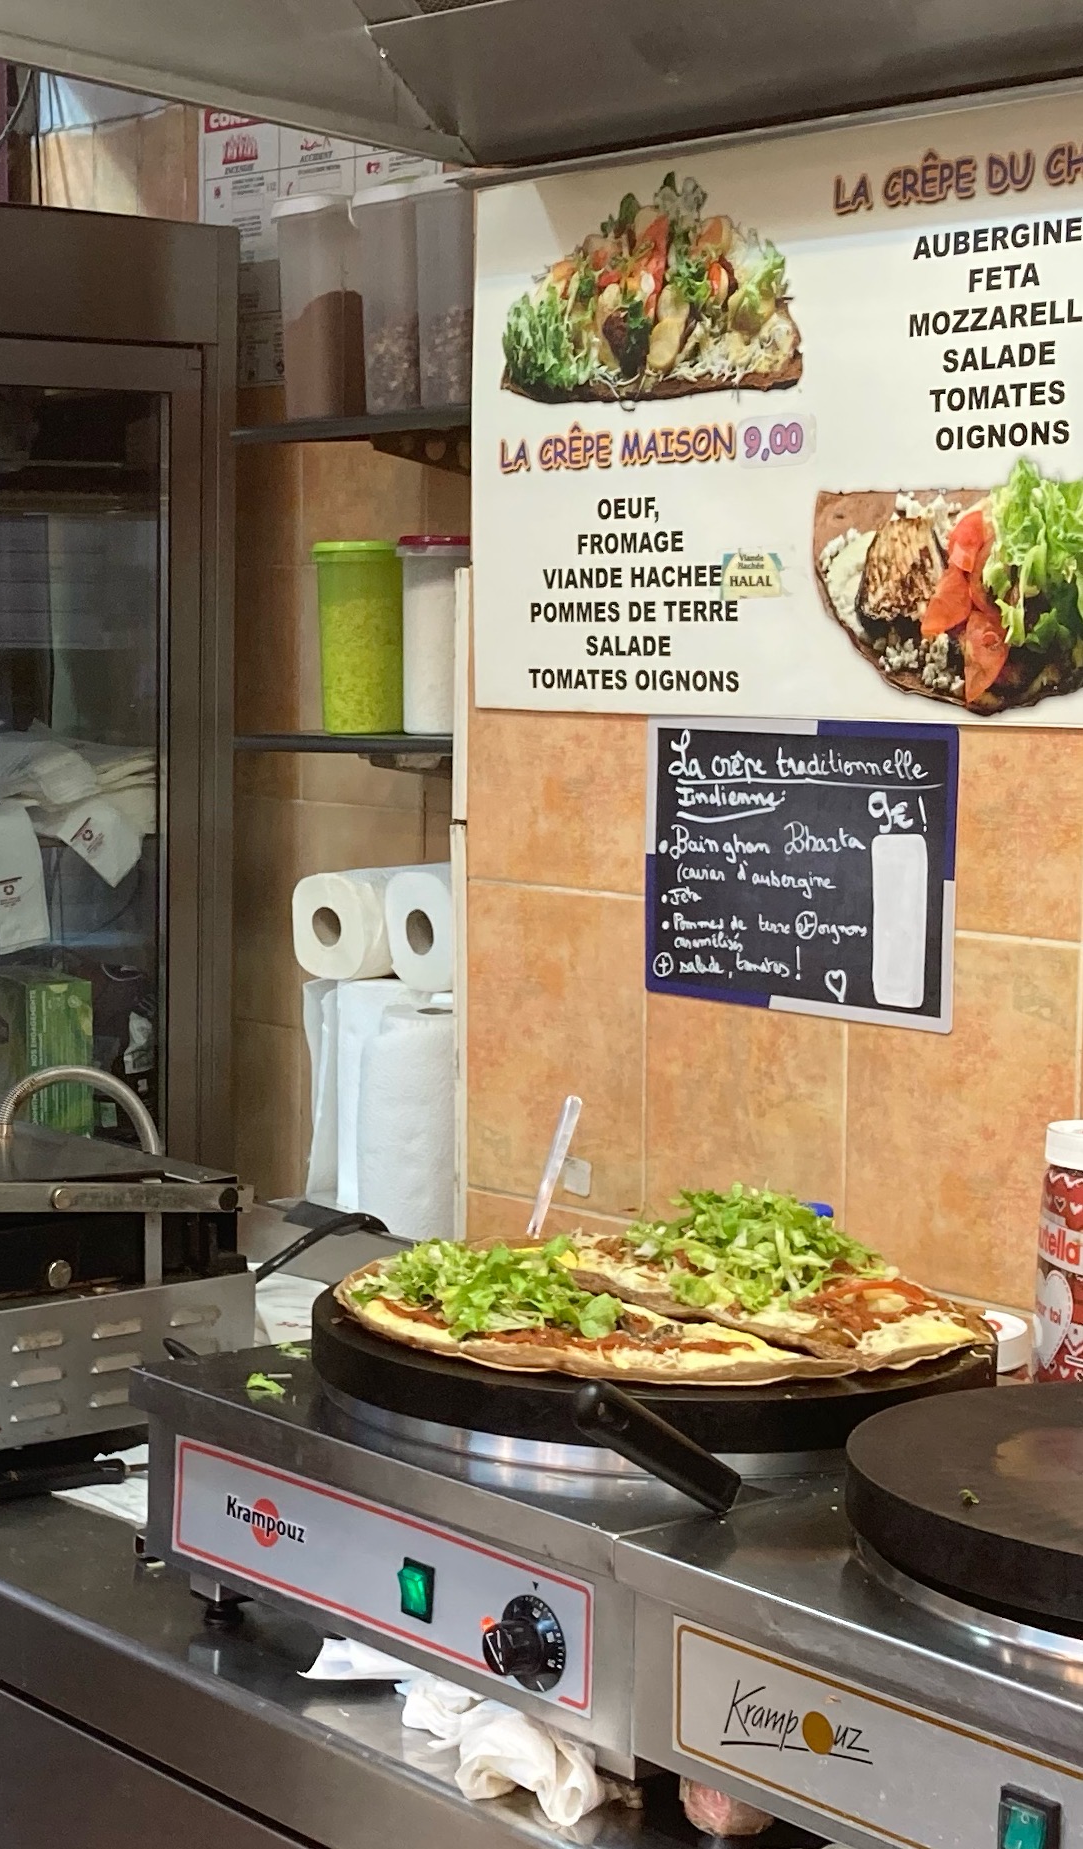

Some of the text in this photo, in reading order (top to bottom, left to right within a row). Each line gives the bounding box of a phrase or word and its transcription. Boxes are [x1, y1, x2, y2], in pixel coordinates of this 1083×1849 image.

[833, 174, 873, 214] LA
[883, 148, 976, 206] CRÊPE
[986, 150, 1034, 194] DU
[913, 217, 1083, 260] AUBERGINE
[969, 262, 1040, 292] FETA
[909, 299, 1083, 337] MOZZARELL
[943, 341, 1056, 373] SALADE
[929, 380, 1065, 412] TOMATES
[500, 422, 735, 474] LA CRÊPE MAISON
[743, 422, 803, 462] 9,00
[936, 420, 1069, 451] OIGNONS
[597, 497, 659, 522] OEUF,
[577, 531, 684, 555] FROMAGE
[543, 565, 721, 589] VIANDE HACHEE
[730, 575, 772, 587] HALAL
[530, 601, 738, 623] POMMES DE TERRE
[586, 635, 671, 657] SALADE
[528, 668, 739, 693] TOMATES OIGNONS
[668, 729, 706, 780] La
[776, 747, 929, 780] traditionnelle
[730, 914, 748, 931] de
[226, 1494, 305, 1544] Krampouz
